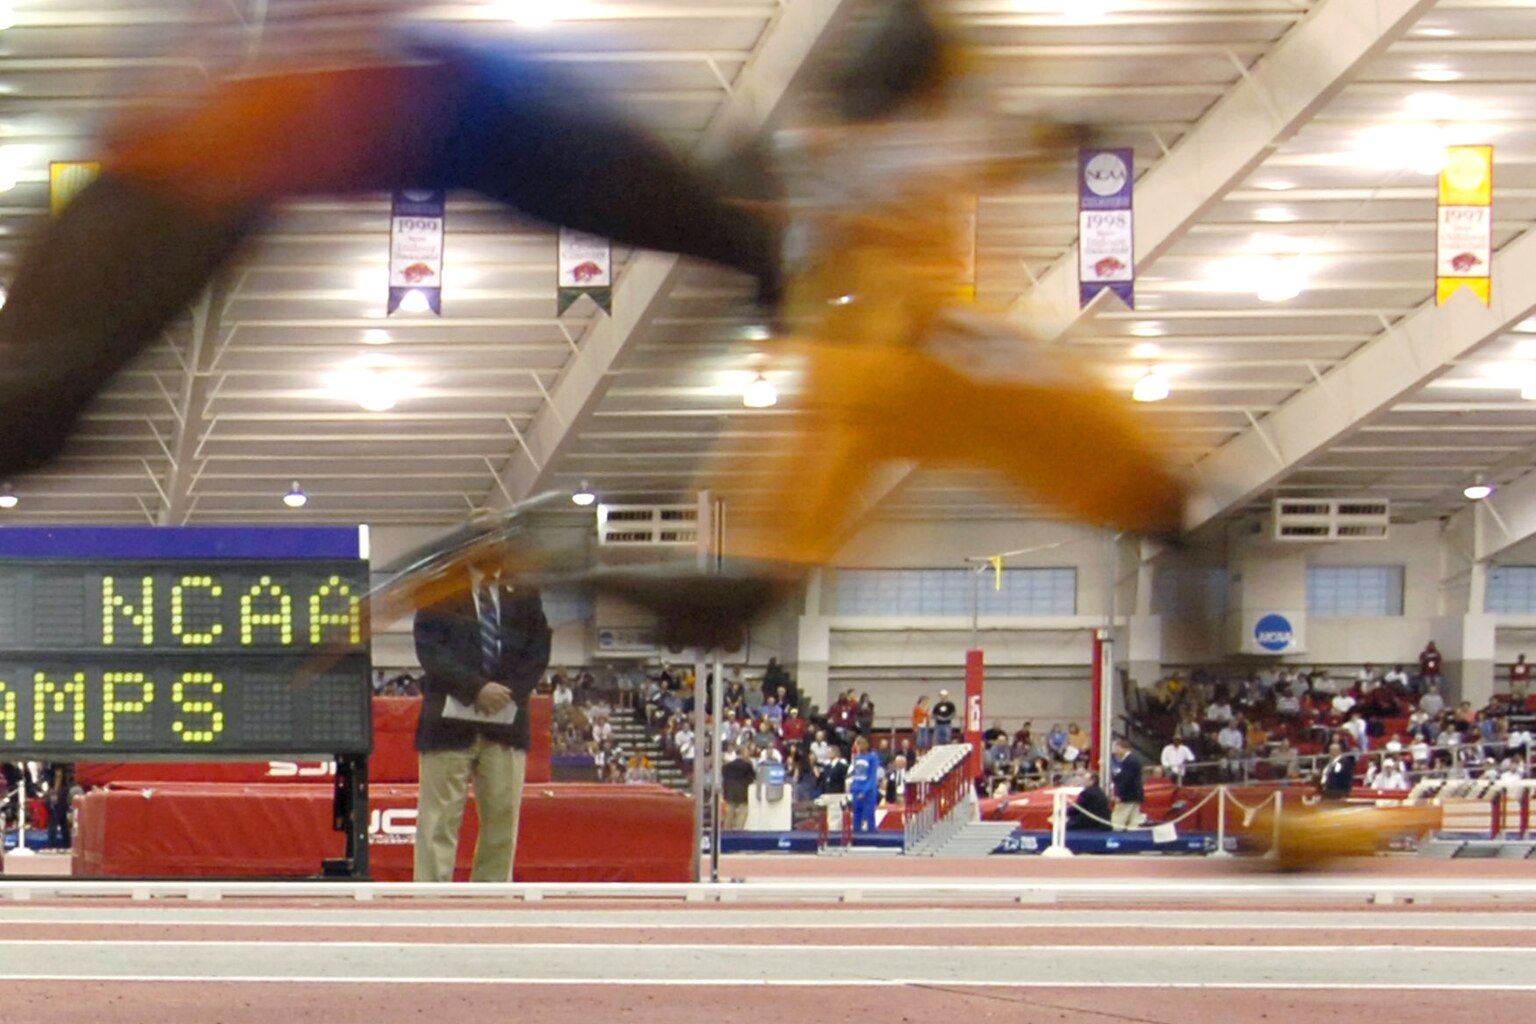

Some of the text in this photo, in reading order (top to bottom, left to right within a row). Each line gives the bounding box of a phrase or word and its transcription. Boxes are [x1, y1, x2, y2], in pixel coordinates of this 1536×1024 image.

[398, 218, 438, 233] 1999
[1086, 214, 1126, 229] 1998
[102, 575, 360, 645] NCAA
